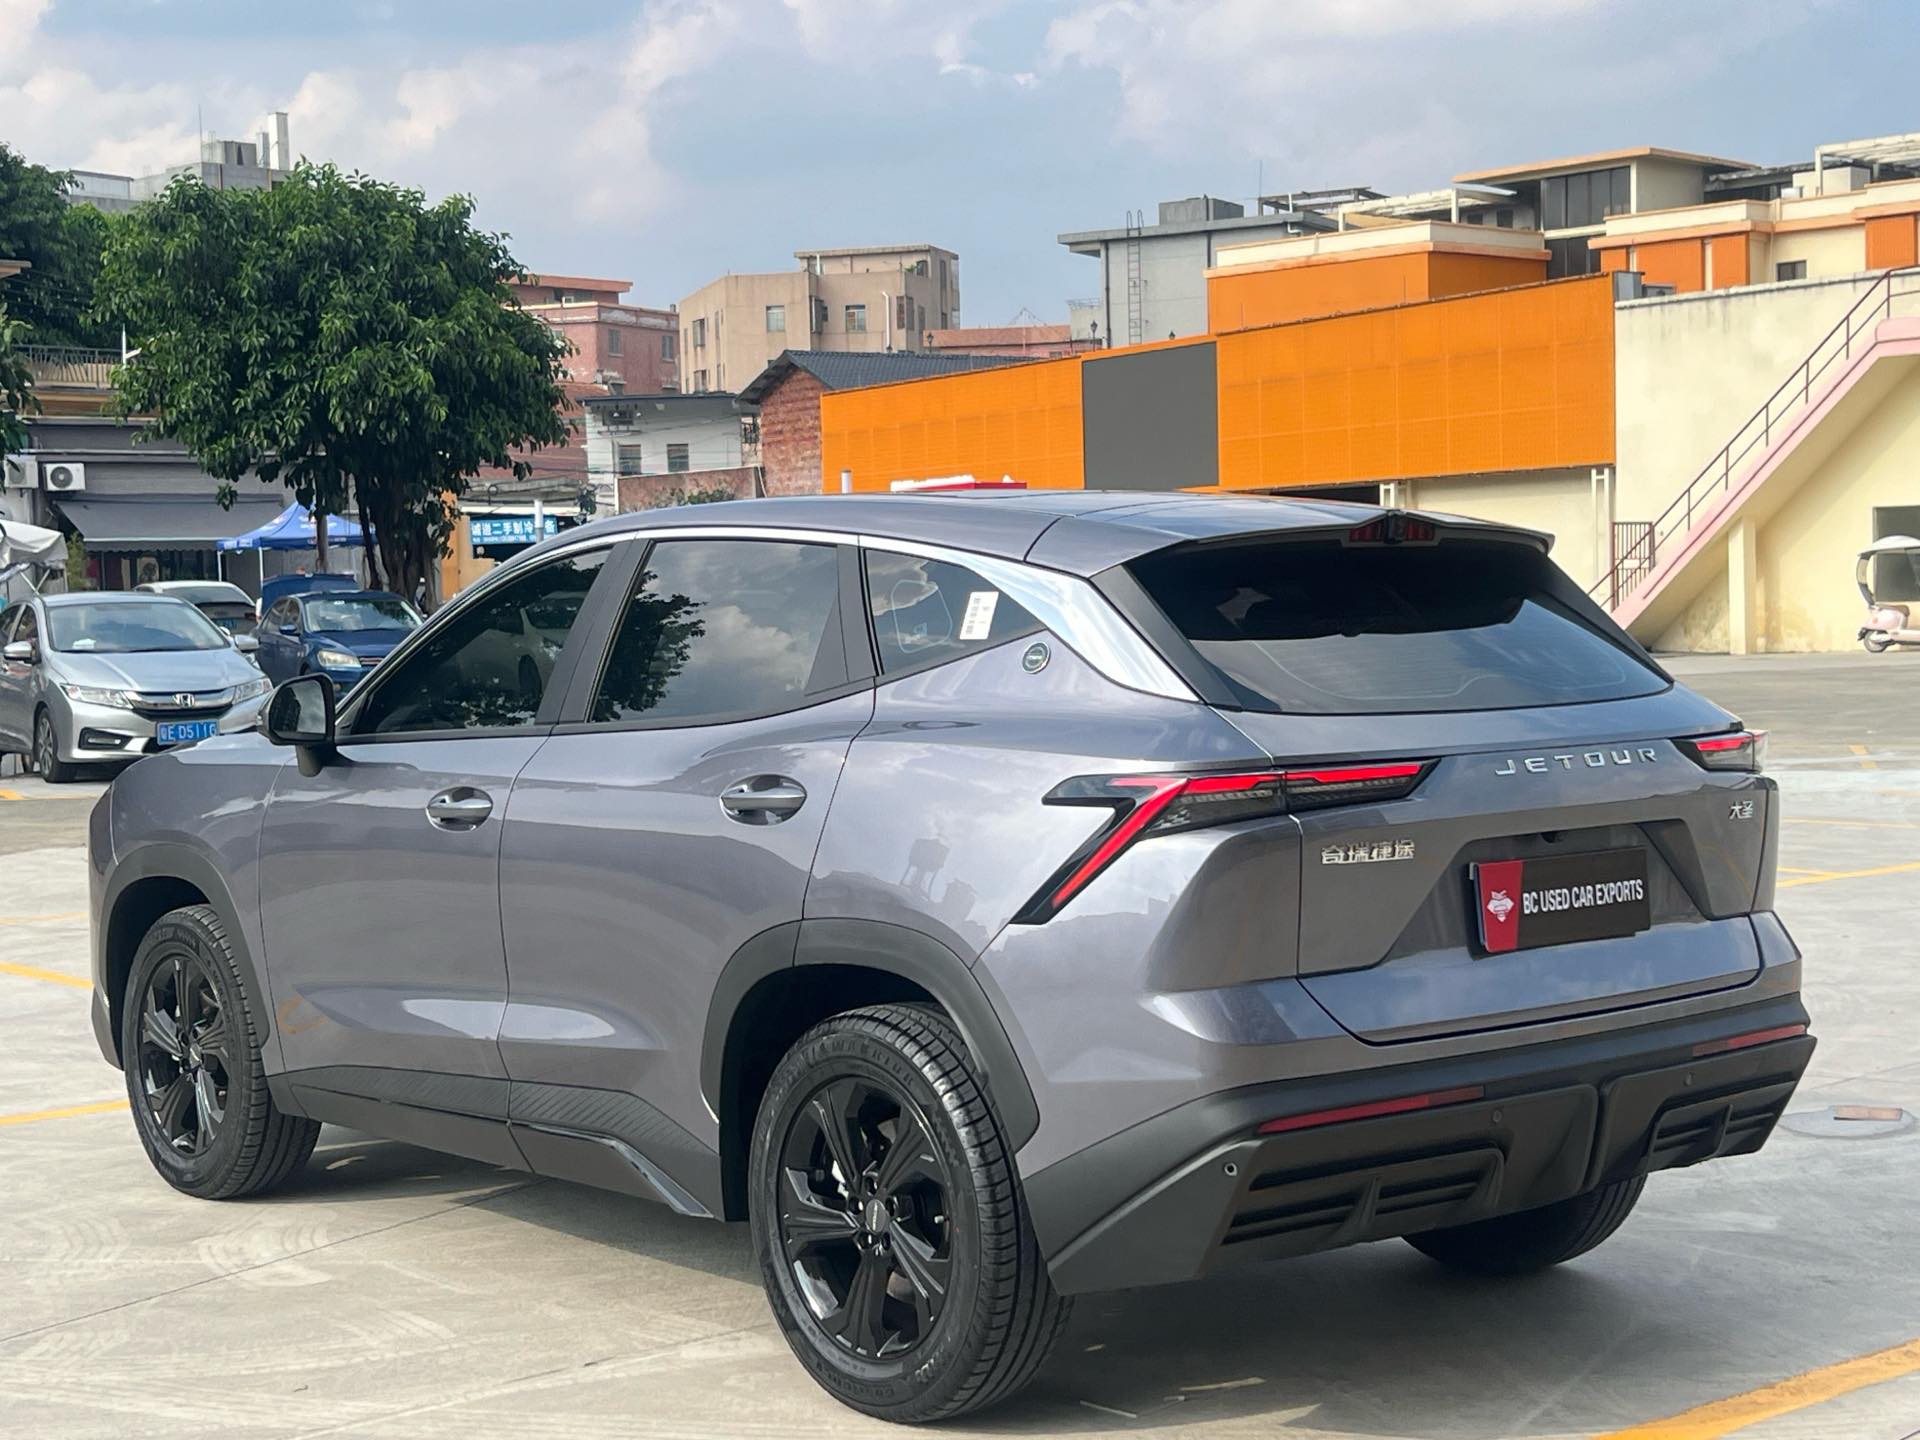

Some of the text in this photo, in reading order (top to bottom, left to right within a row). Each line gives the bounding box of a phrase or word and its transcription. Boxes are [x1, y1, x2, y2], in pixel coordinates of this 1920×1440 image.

[1495, 748, 1657, 776] JETOUR
[1729, 800, 1753, 820] 大圣
[1321, 839, 1415, 865] 奇瑞捷途
[1522, 878, 1644, 915] BC USED CAR EXPORTS
